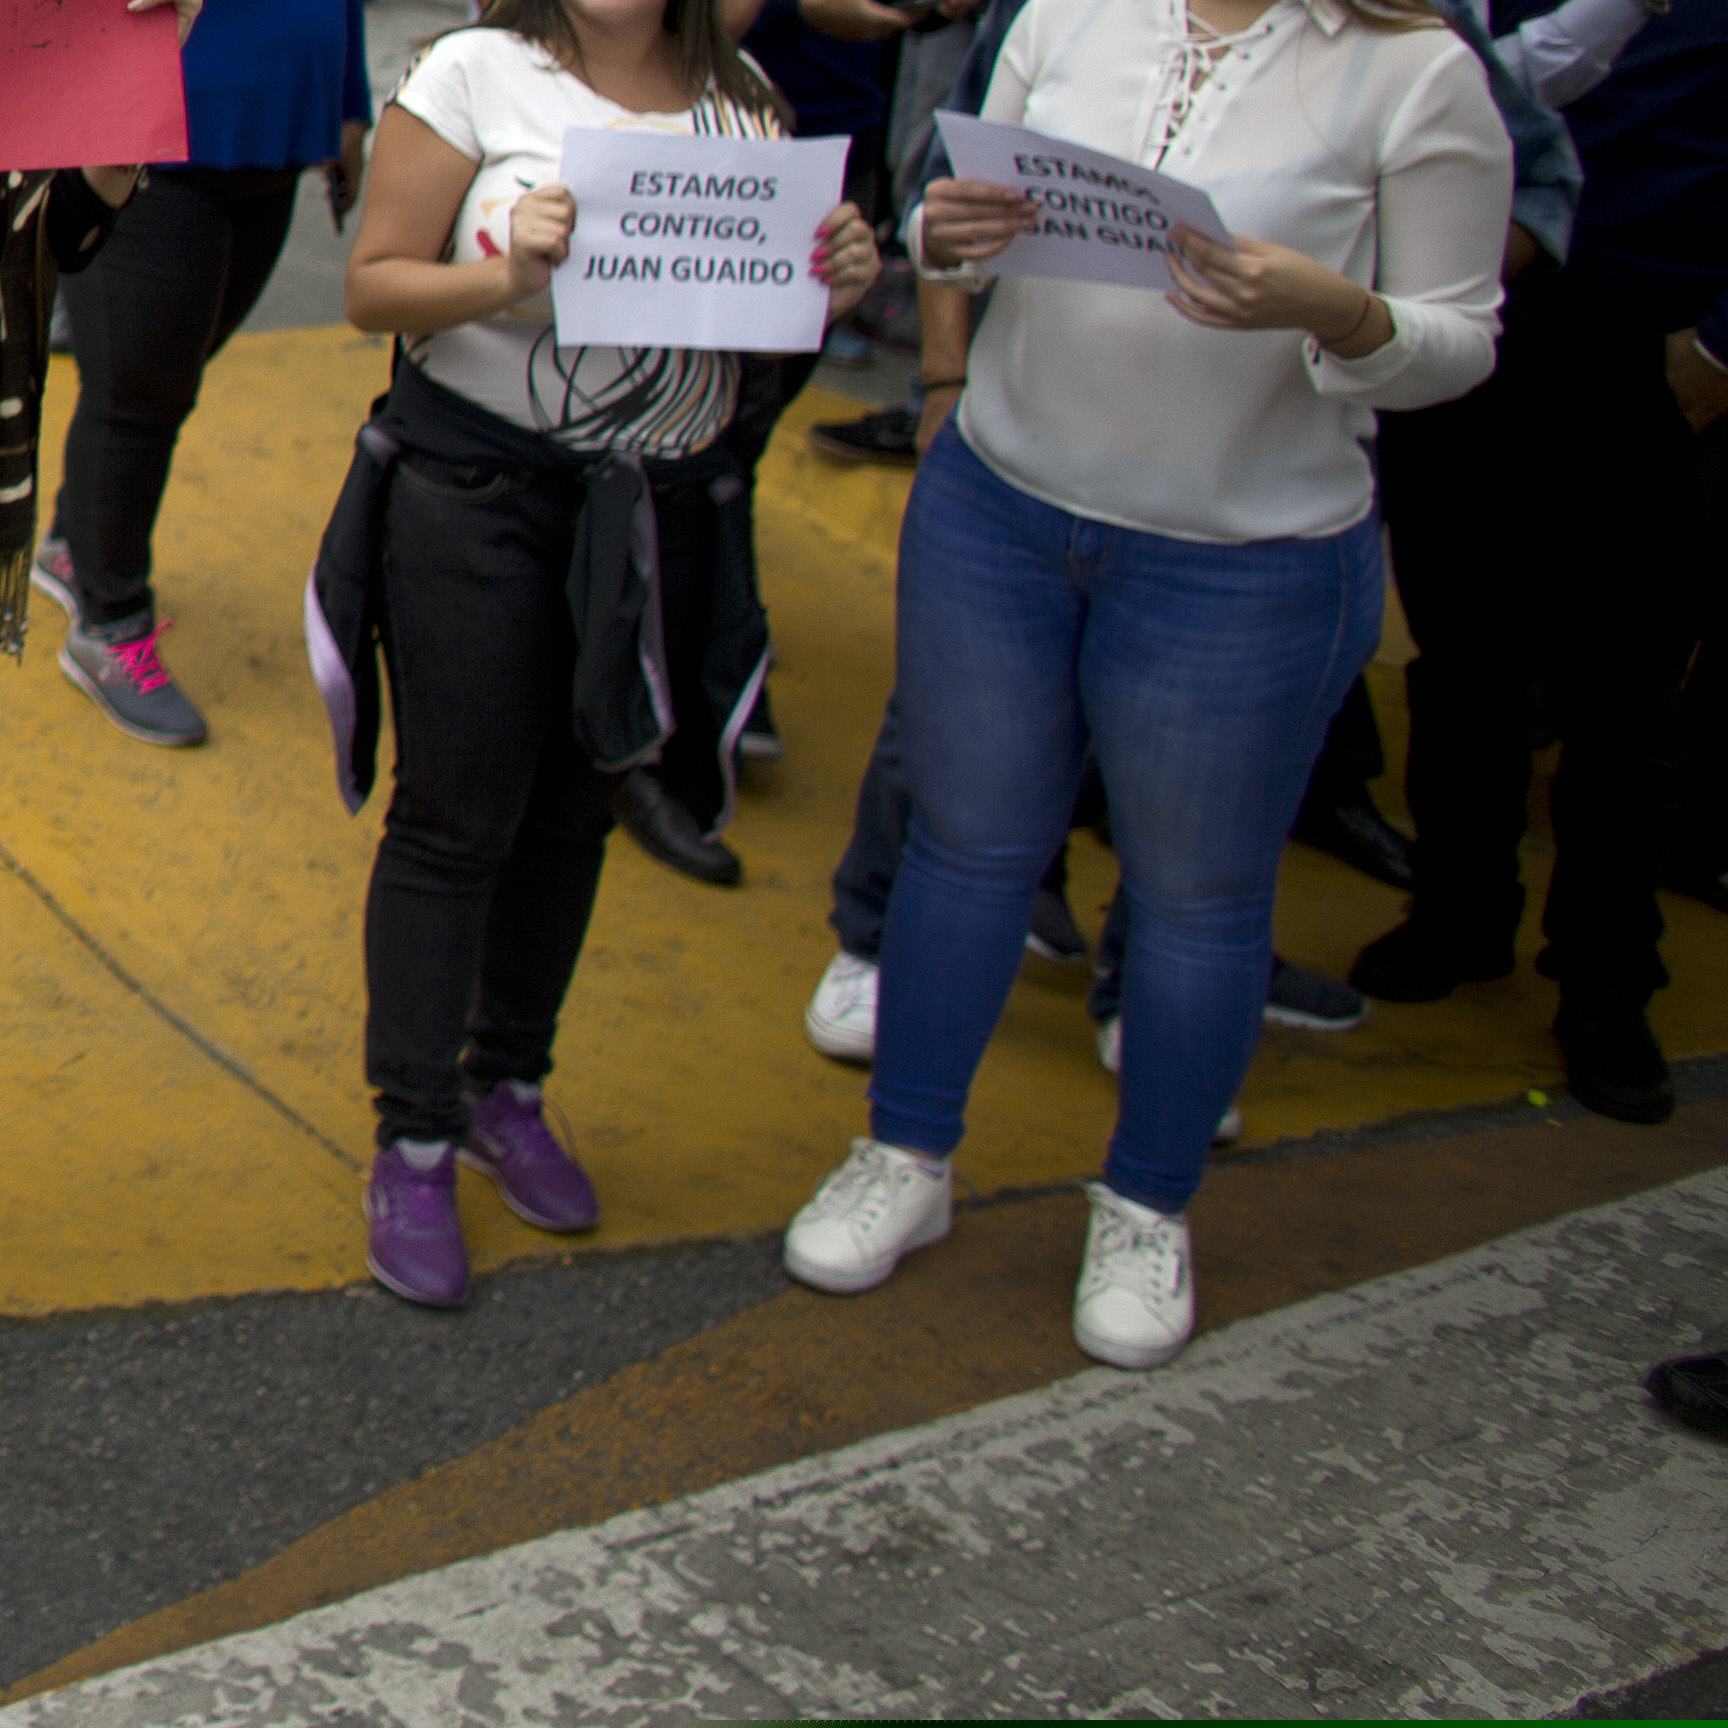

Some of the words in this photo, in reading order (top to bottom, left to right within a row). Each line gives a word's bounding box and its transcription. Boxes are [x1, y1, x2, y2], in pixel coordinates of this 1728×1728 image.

[630, 171, 777, 201] ESTAMOS
[620, 212, 767, 244] CONTIGO,
[583, 255, 662, 281] JUAN
[671, 256, 794, 285] GUAIDO
